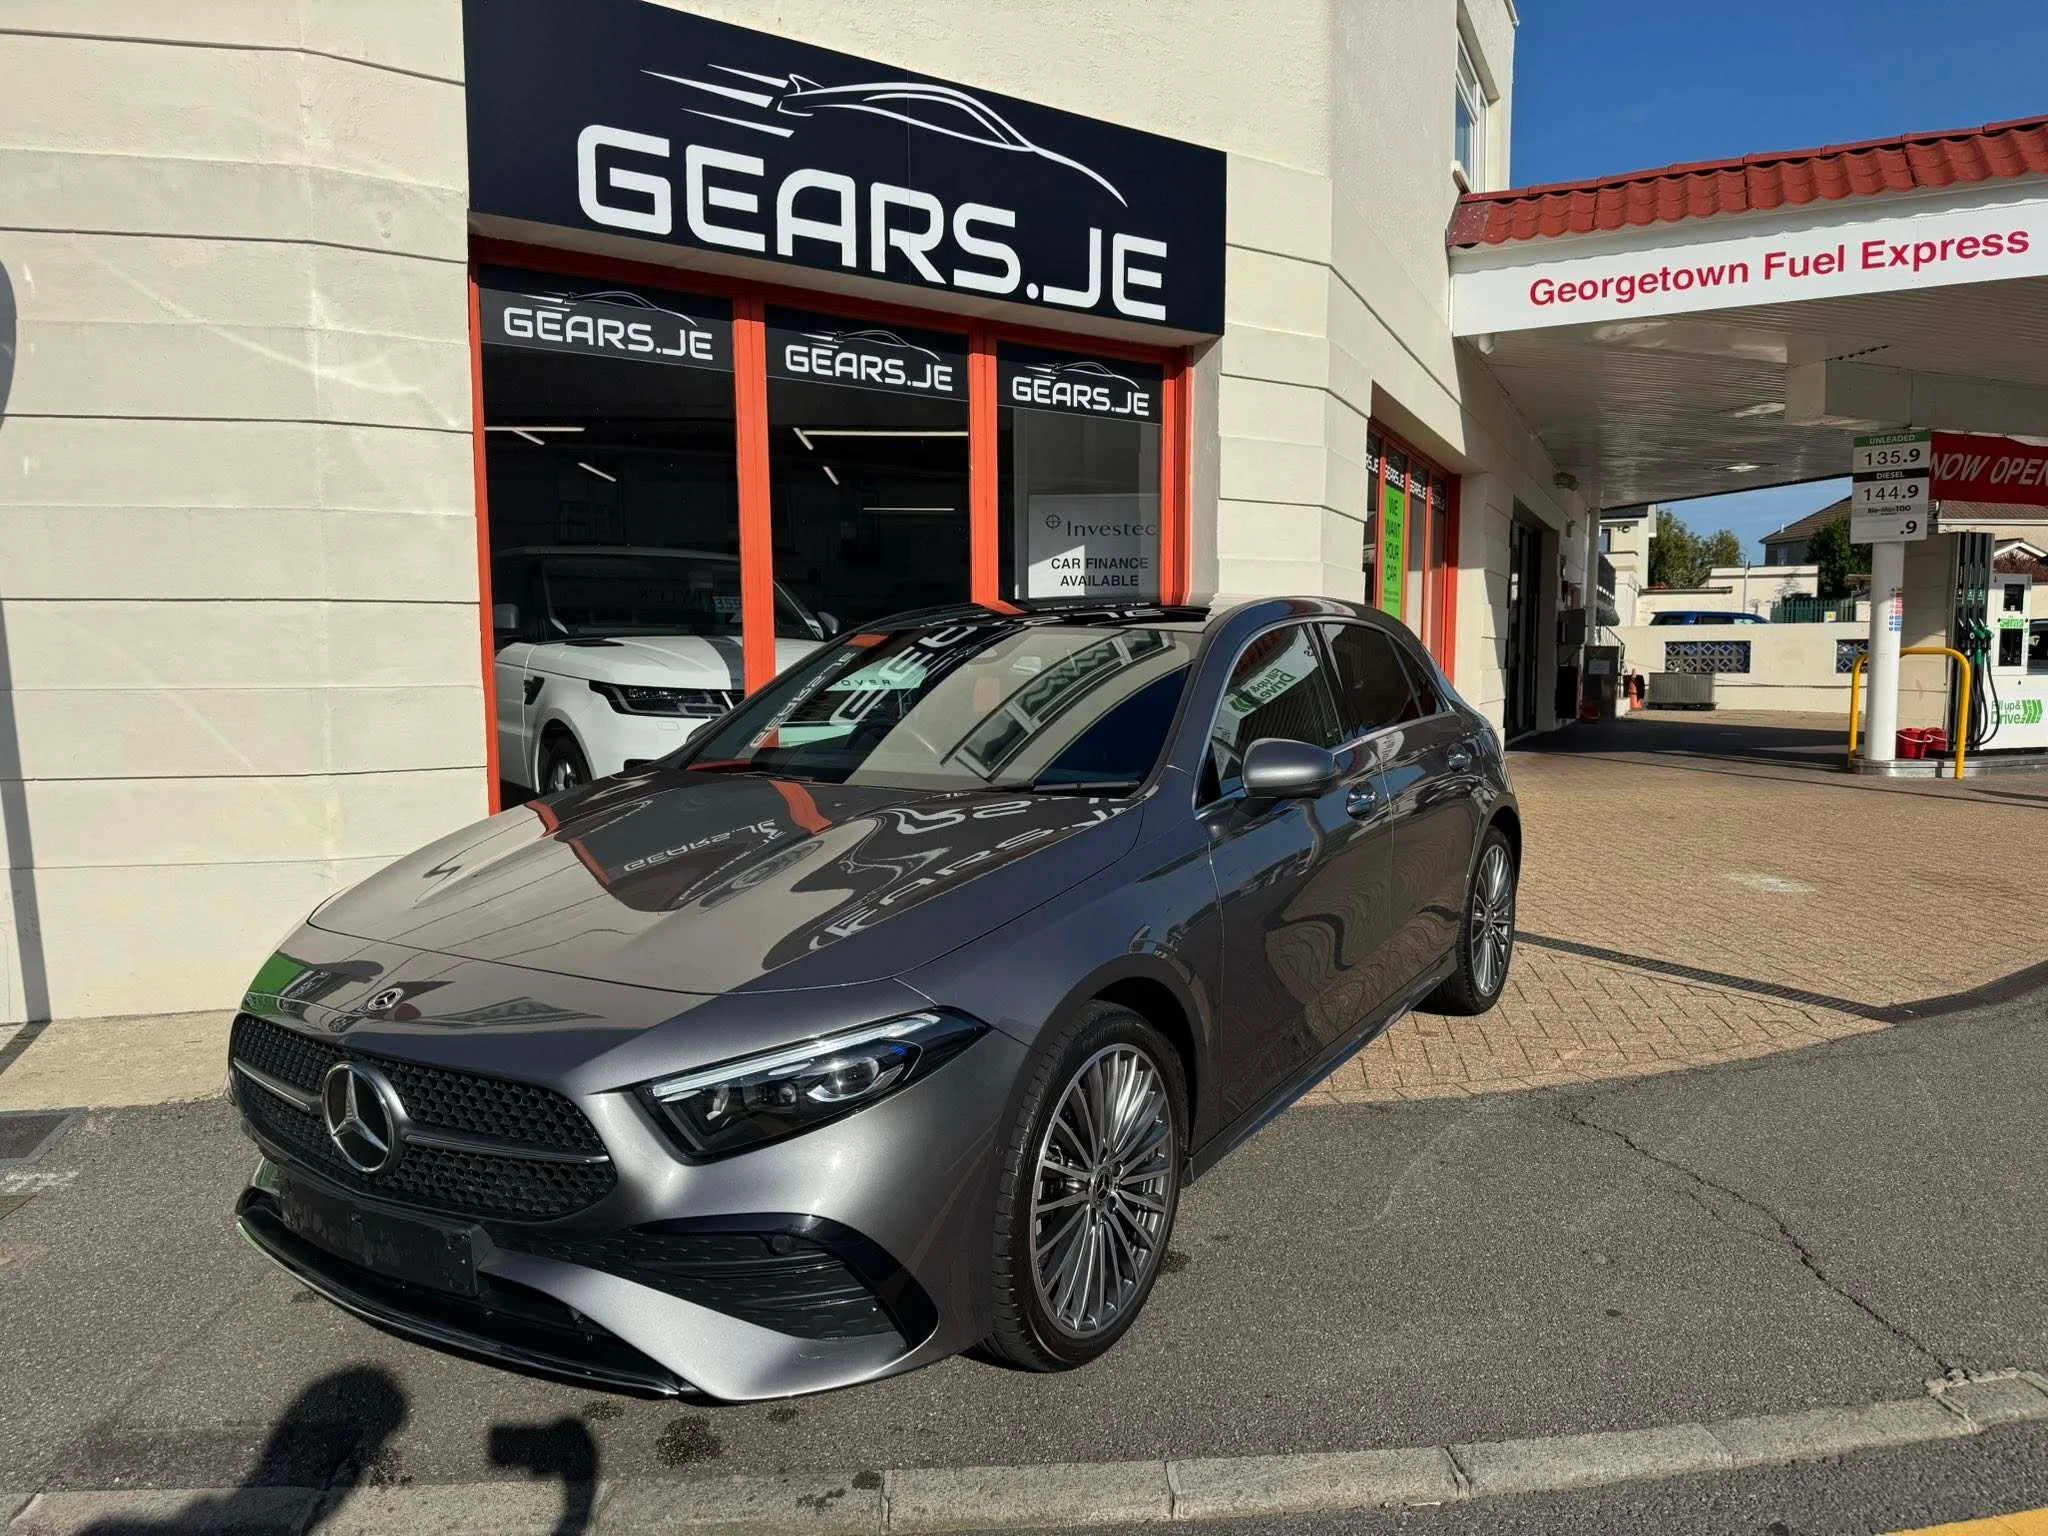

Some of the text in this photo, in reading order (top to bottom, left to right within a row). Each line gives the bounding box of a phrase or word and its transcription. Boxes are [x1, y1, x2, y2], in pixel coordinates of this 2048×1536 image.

[577, 124, 1167, 321] GEARS.JE
[1529, 230, 2029, 305] Georgetown Fuel Express
[504, 307, 713, 360] GEARS.JE
[785, 344, 953, 391] GEARS.JE
[1012, 376, 1150, 416] GEARS.JE
[1869, 434, 1915, 444] UNLEADED
[1865, 448, 1920, 466] 135.9
[1876, 471, 1905, 480] DIESEL
[1929, 453, 1990, 482] NOW
[1864, 485, 1919, 501] 144.9
[1067, 520, 1157, 537] Investec
[1051, 557, 1149, 570] CAR FINANCE
[1060, 575, 1139, 587] AVAILABLE
[841, 679, 891, 687] OVER
